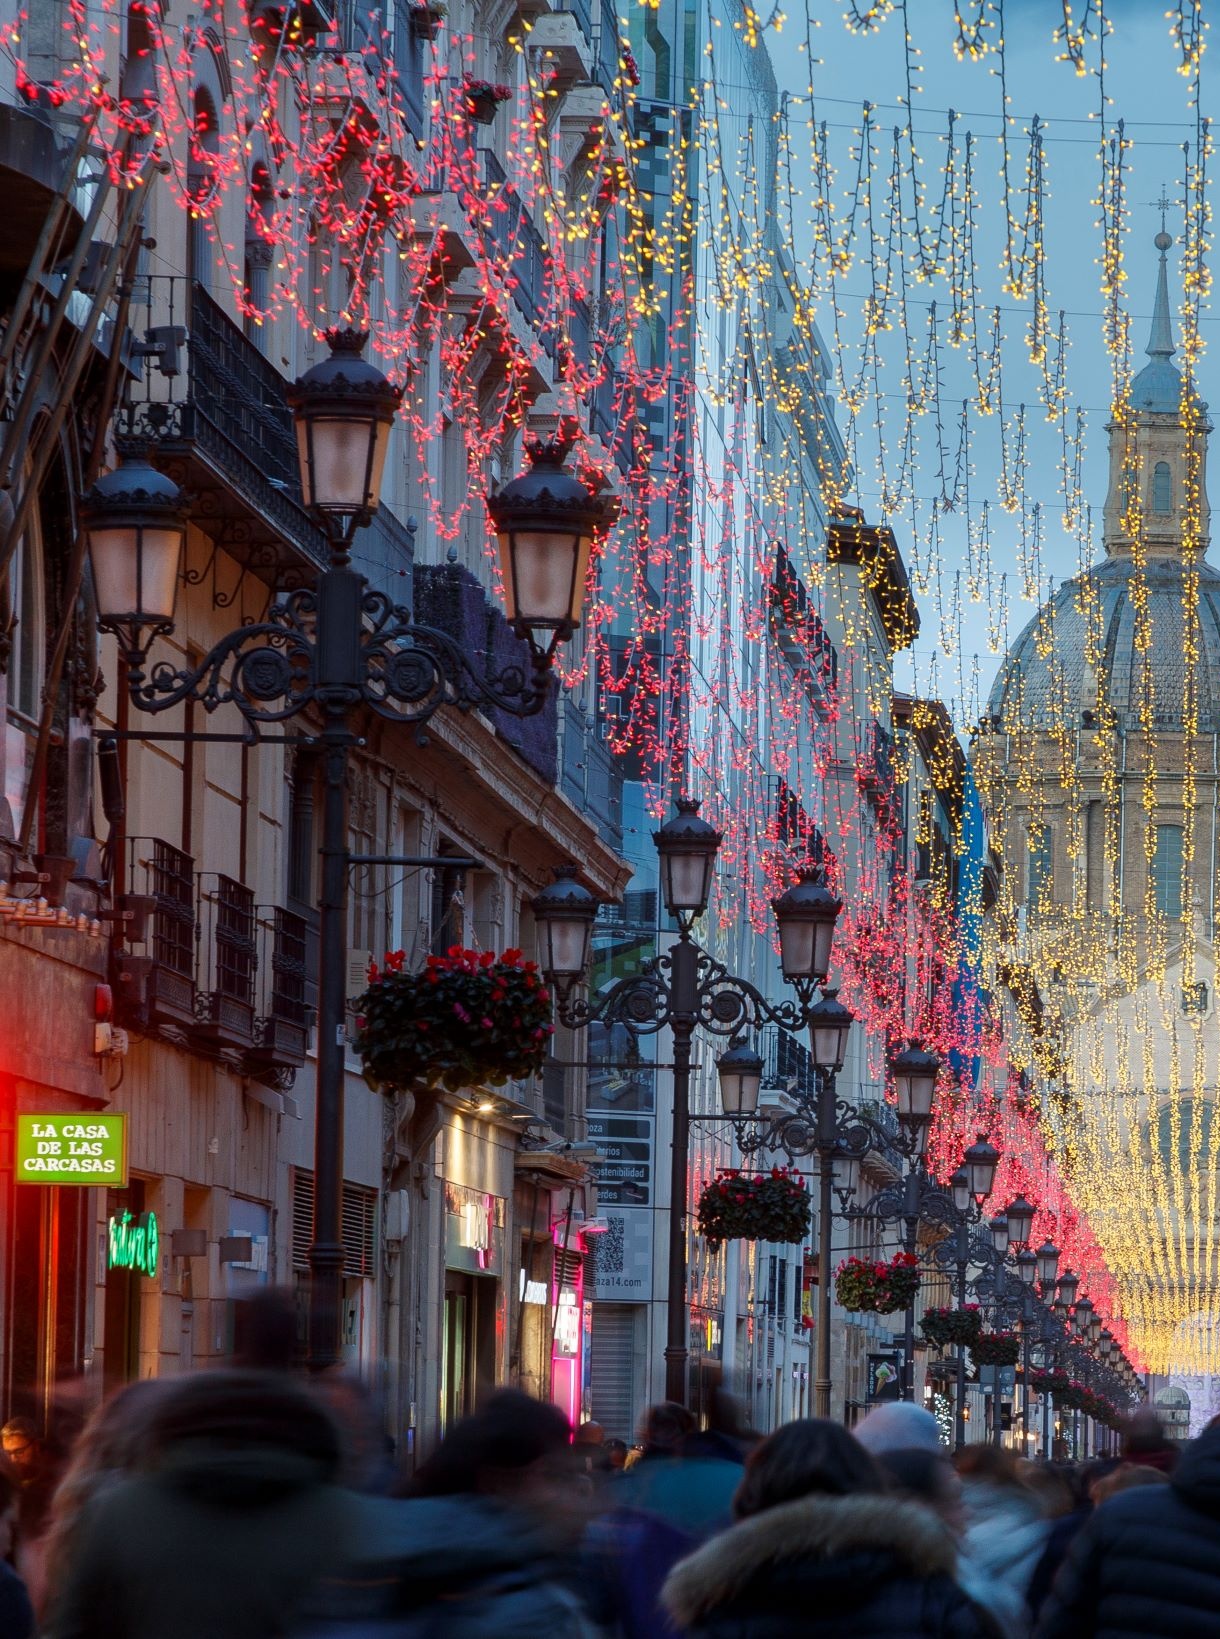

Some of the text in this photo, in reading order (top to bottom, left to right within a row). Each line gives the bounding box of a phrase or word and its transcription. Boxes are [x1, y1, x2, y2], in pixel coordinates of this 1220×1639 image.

[32, 1124, 110, 1139] LA CASA
[37, 1142, 103, 1155] DE LAS
[24, 1158, 116, 1173] CARCASAS
[597, 1190, 618, 1199] erdes
[596, 1277, 642, 1287] aza14.com
